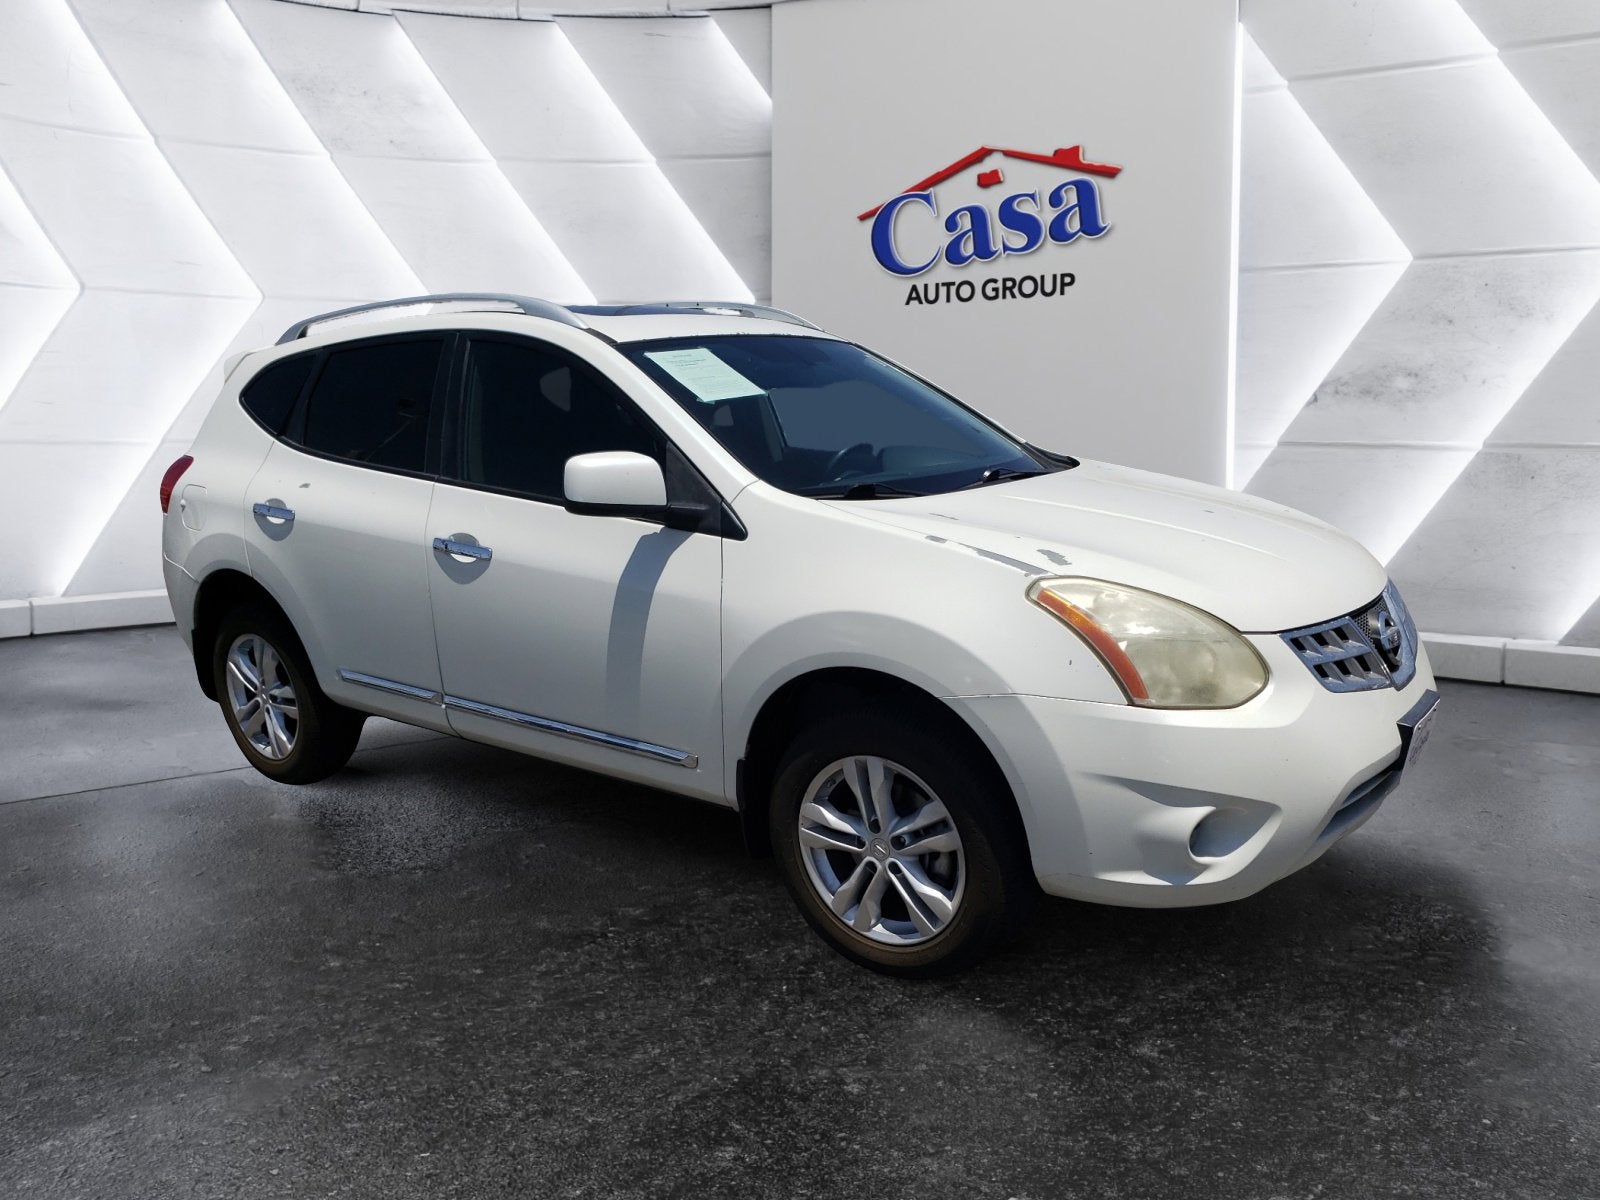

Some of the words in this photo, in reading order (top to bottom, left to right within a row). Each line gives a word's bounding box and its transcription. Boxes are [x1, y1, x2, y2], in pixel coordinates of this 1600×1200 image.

[871, 176, 1111, 277] Casa
[905, 280, 975, 305] AUTO
[981, 272, 1076, 302] GROUP
